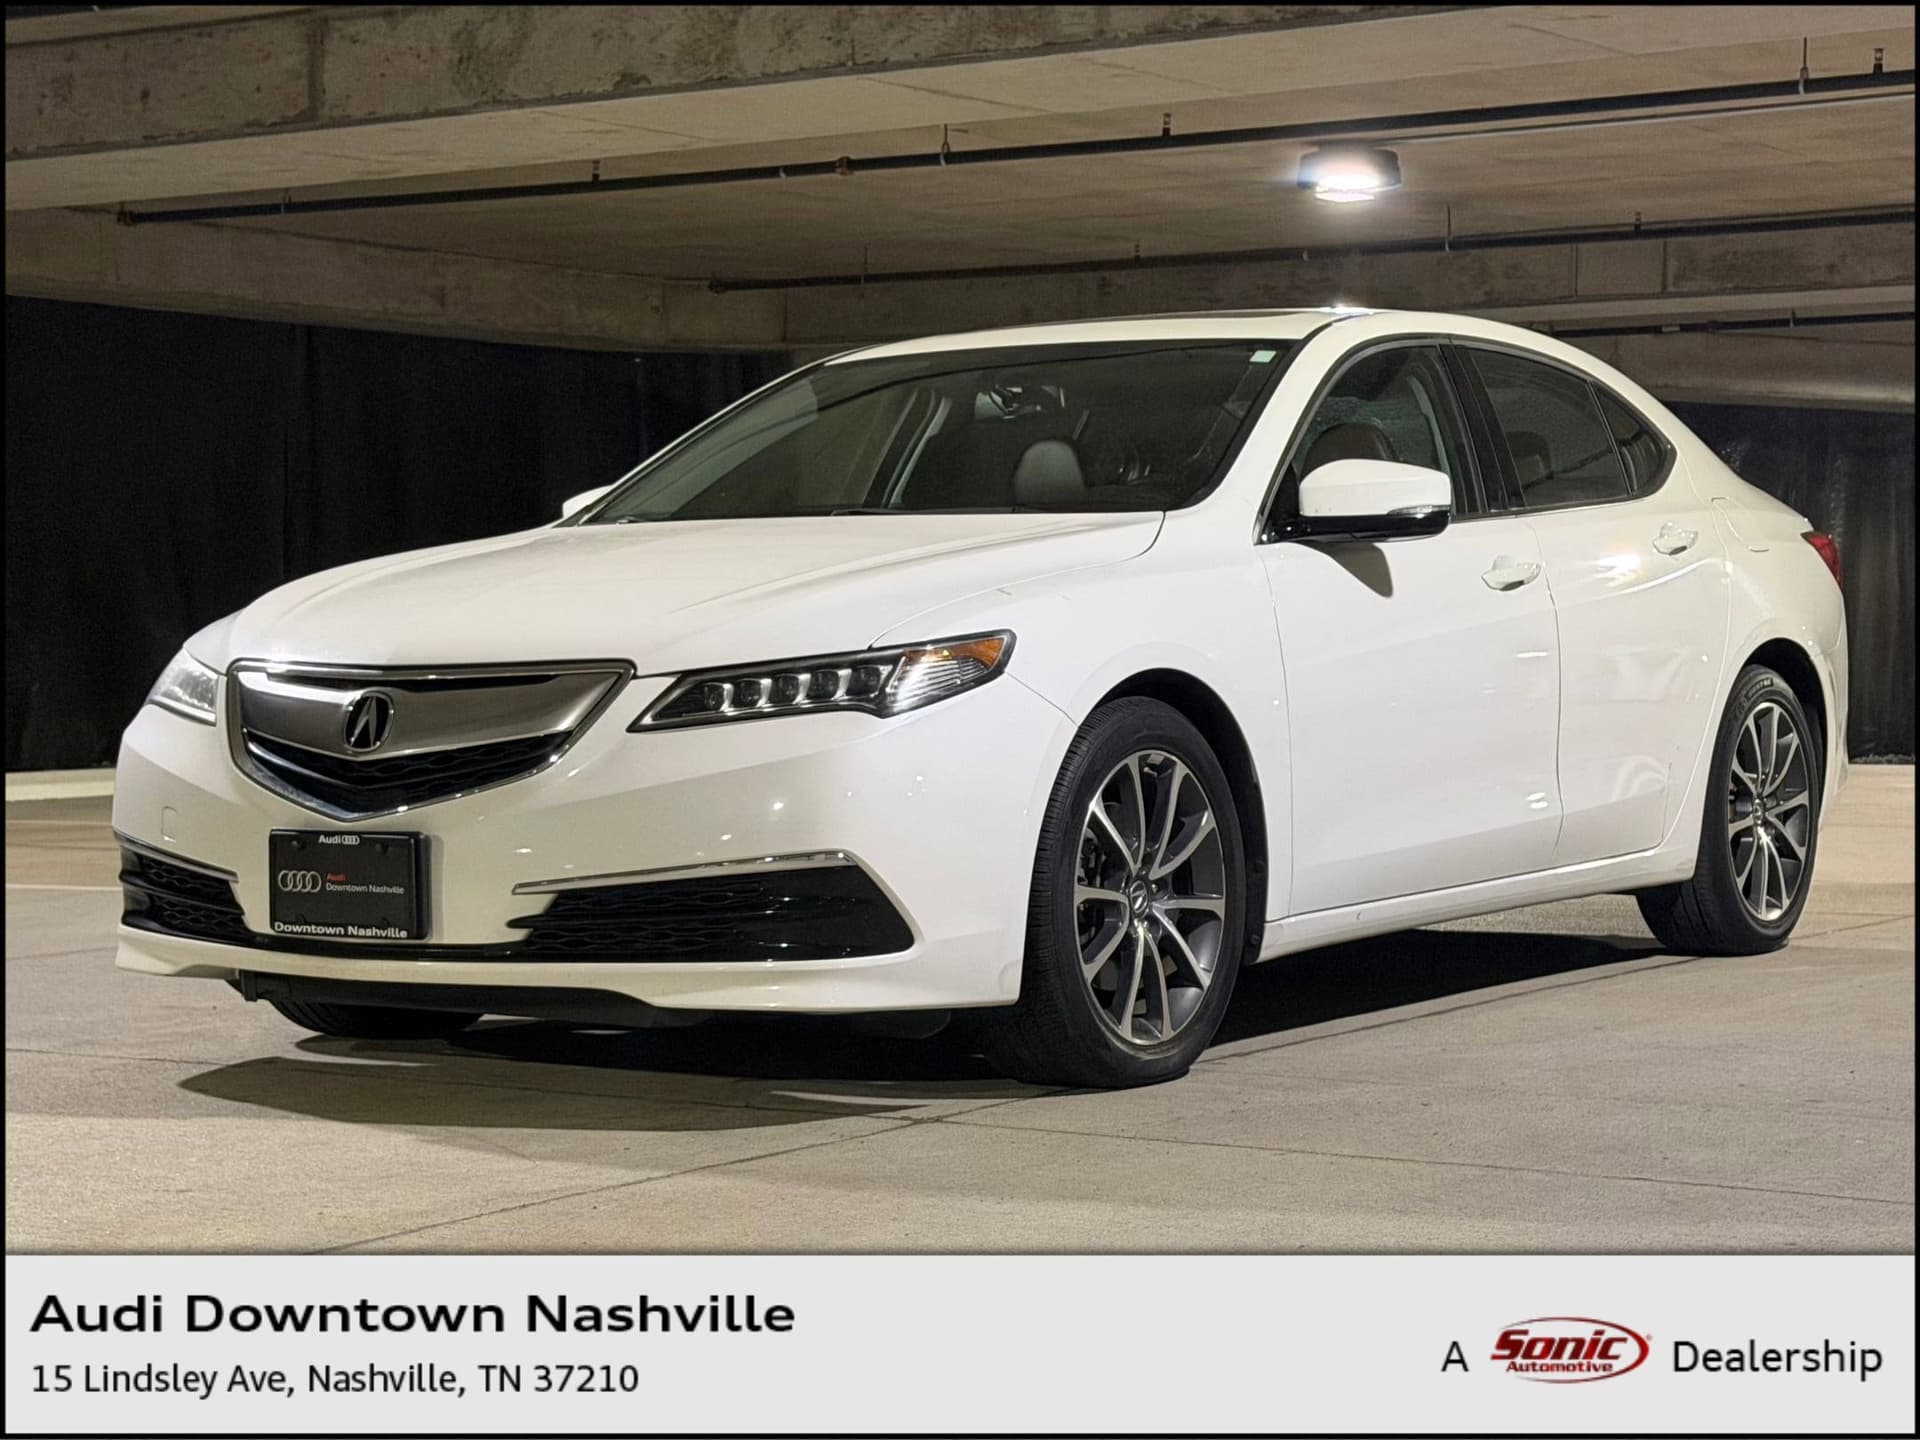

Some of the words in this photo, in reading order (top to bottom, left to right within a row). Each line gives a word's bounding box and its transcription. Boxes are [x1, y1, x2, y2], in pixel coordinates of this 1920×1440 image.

[319, 835, 341, 844] Audi
[326, 873, 346, 881] Audi
[326, 883, 368, 893] Downtown
[369, 885, 405, 895] Nashville
[274, 921, 345, 936] Downtown
[348, 925, 408, 939] Nashville
